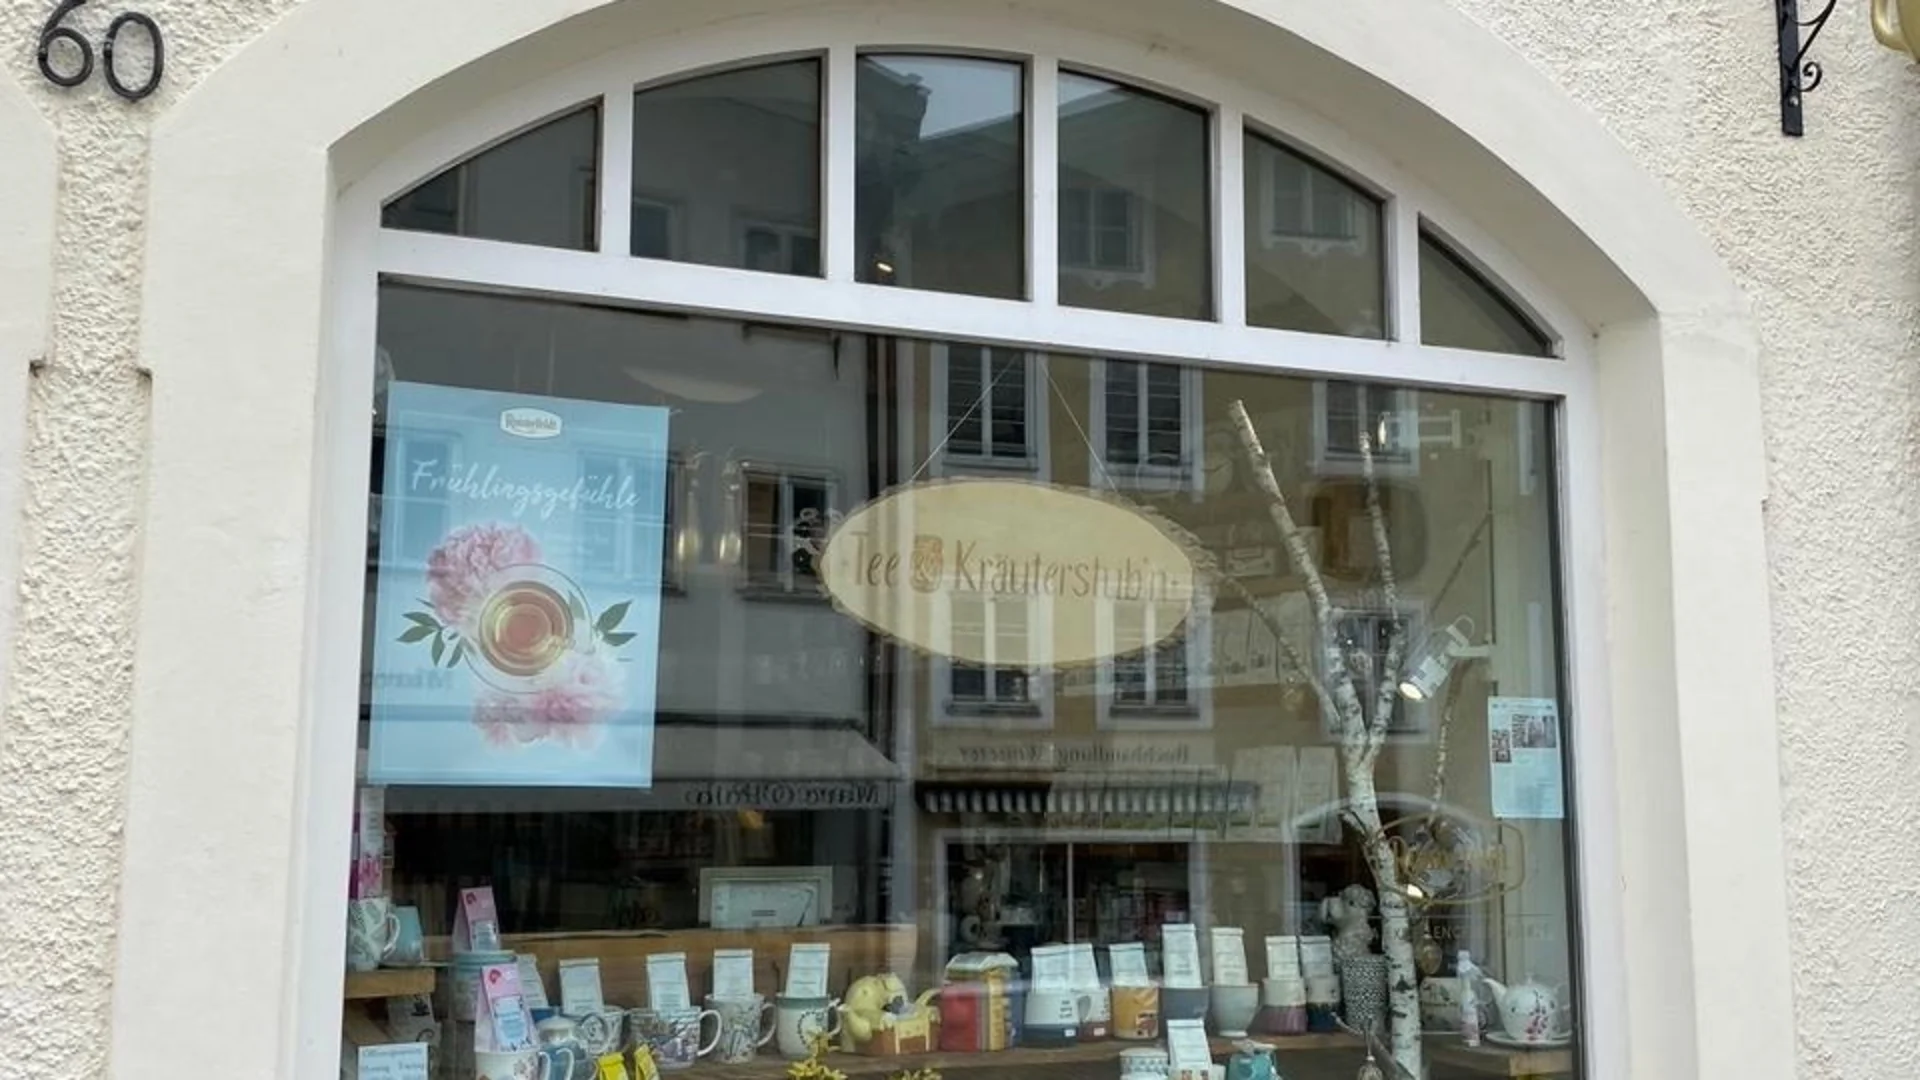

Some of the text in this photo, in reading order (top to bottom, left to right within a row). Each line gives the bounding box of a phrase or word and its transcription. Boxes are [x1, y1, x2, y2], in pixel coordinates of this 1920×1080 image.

[38, 0, 164, 101] 60
[411, 458, 641, 522] Frühlingsgefühle
[849, 530, 901, 588] Tee
